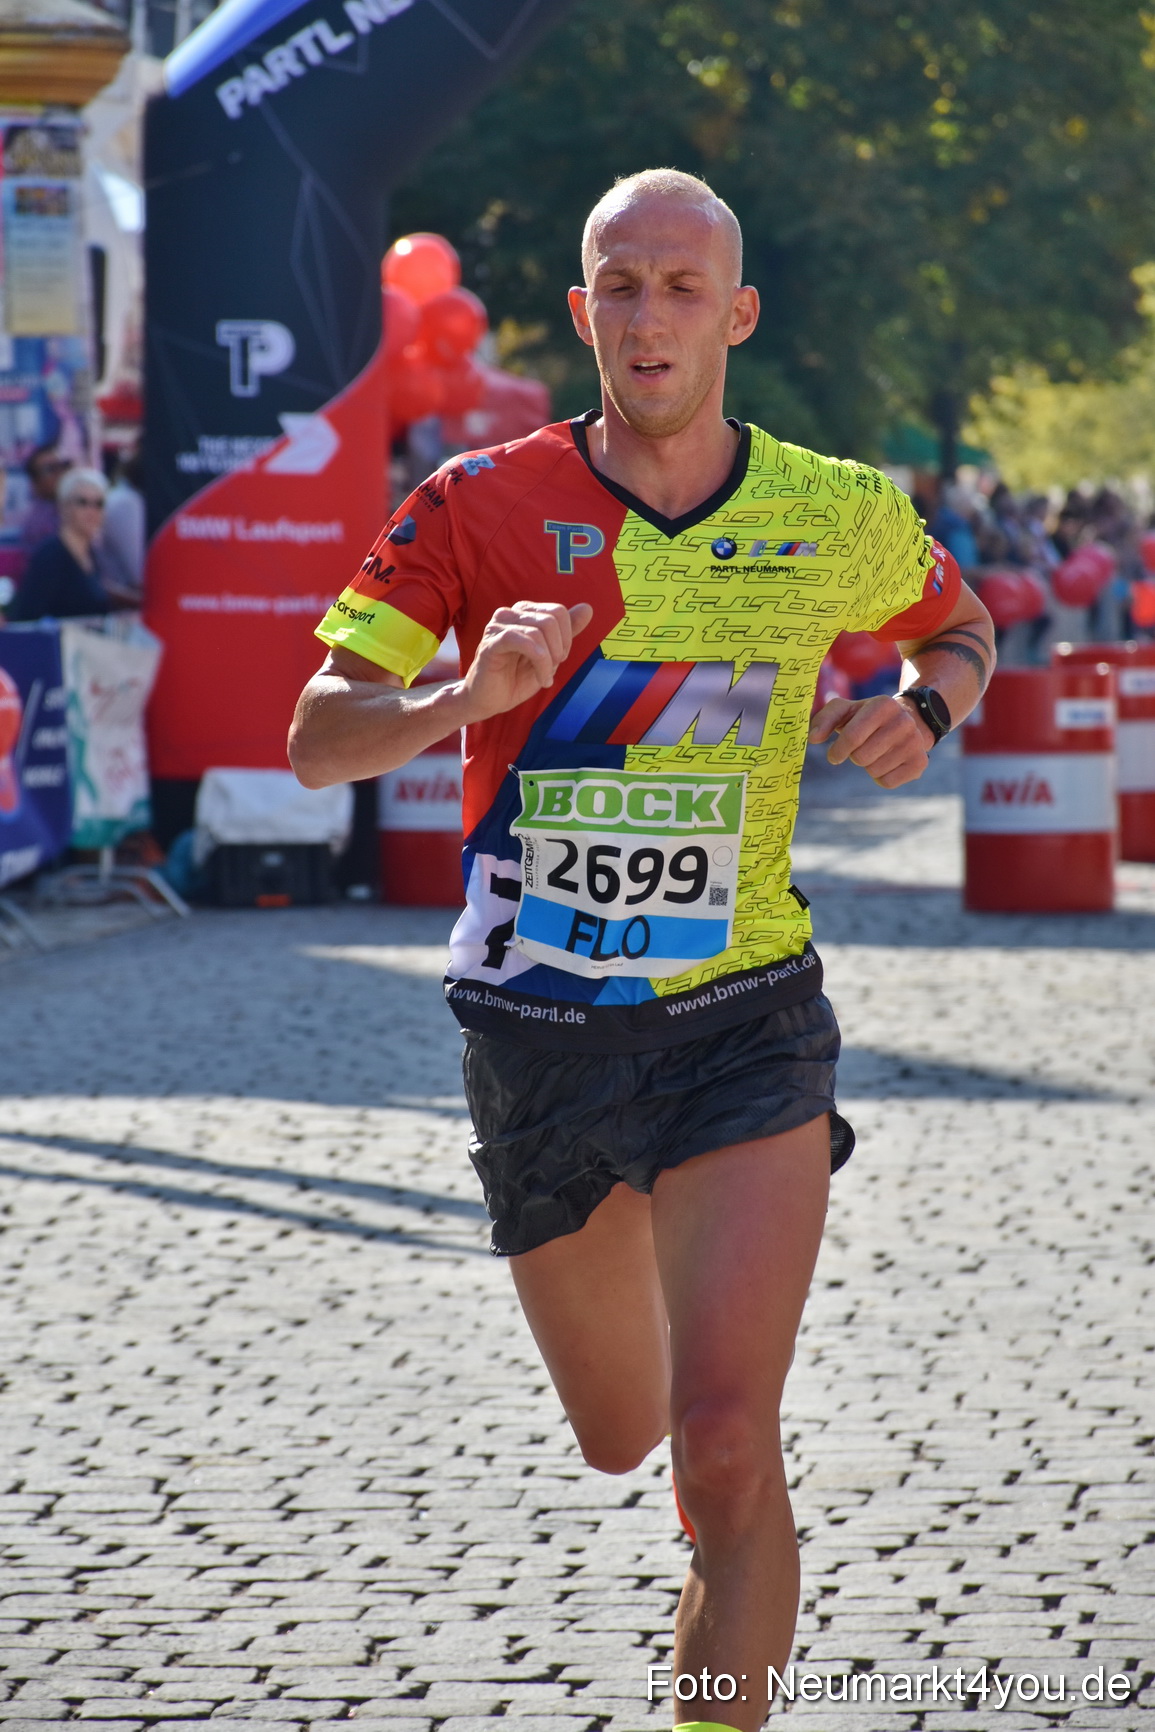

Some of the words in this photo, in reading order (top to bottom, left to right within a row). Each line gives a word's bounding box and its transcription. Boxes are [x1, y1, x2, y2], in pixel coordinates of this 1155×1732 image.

[215, 17, 355, 120] PARTL
[176, 515, 231, 540] BMW
[234, 515, 344, 546] Laufsport
[710, 565, 741, 573] PARTL
[743, 566, 797, 574] NEUMARKT
[532, 780, 726, 828] BOCK
[545, 838, 709, 906] 2699
[565, 909, 651, 962] FLO
[666, 952, 816, 1017] www.bmw-partl.de
